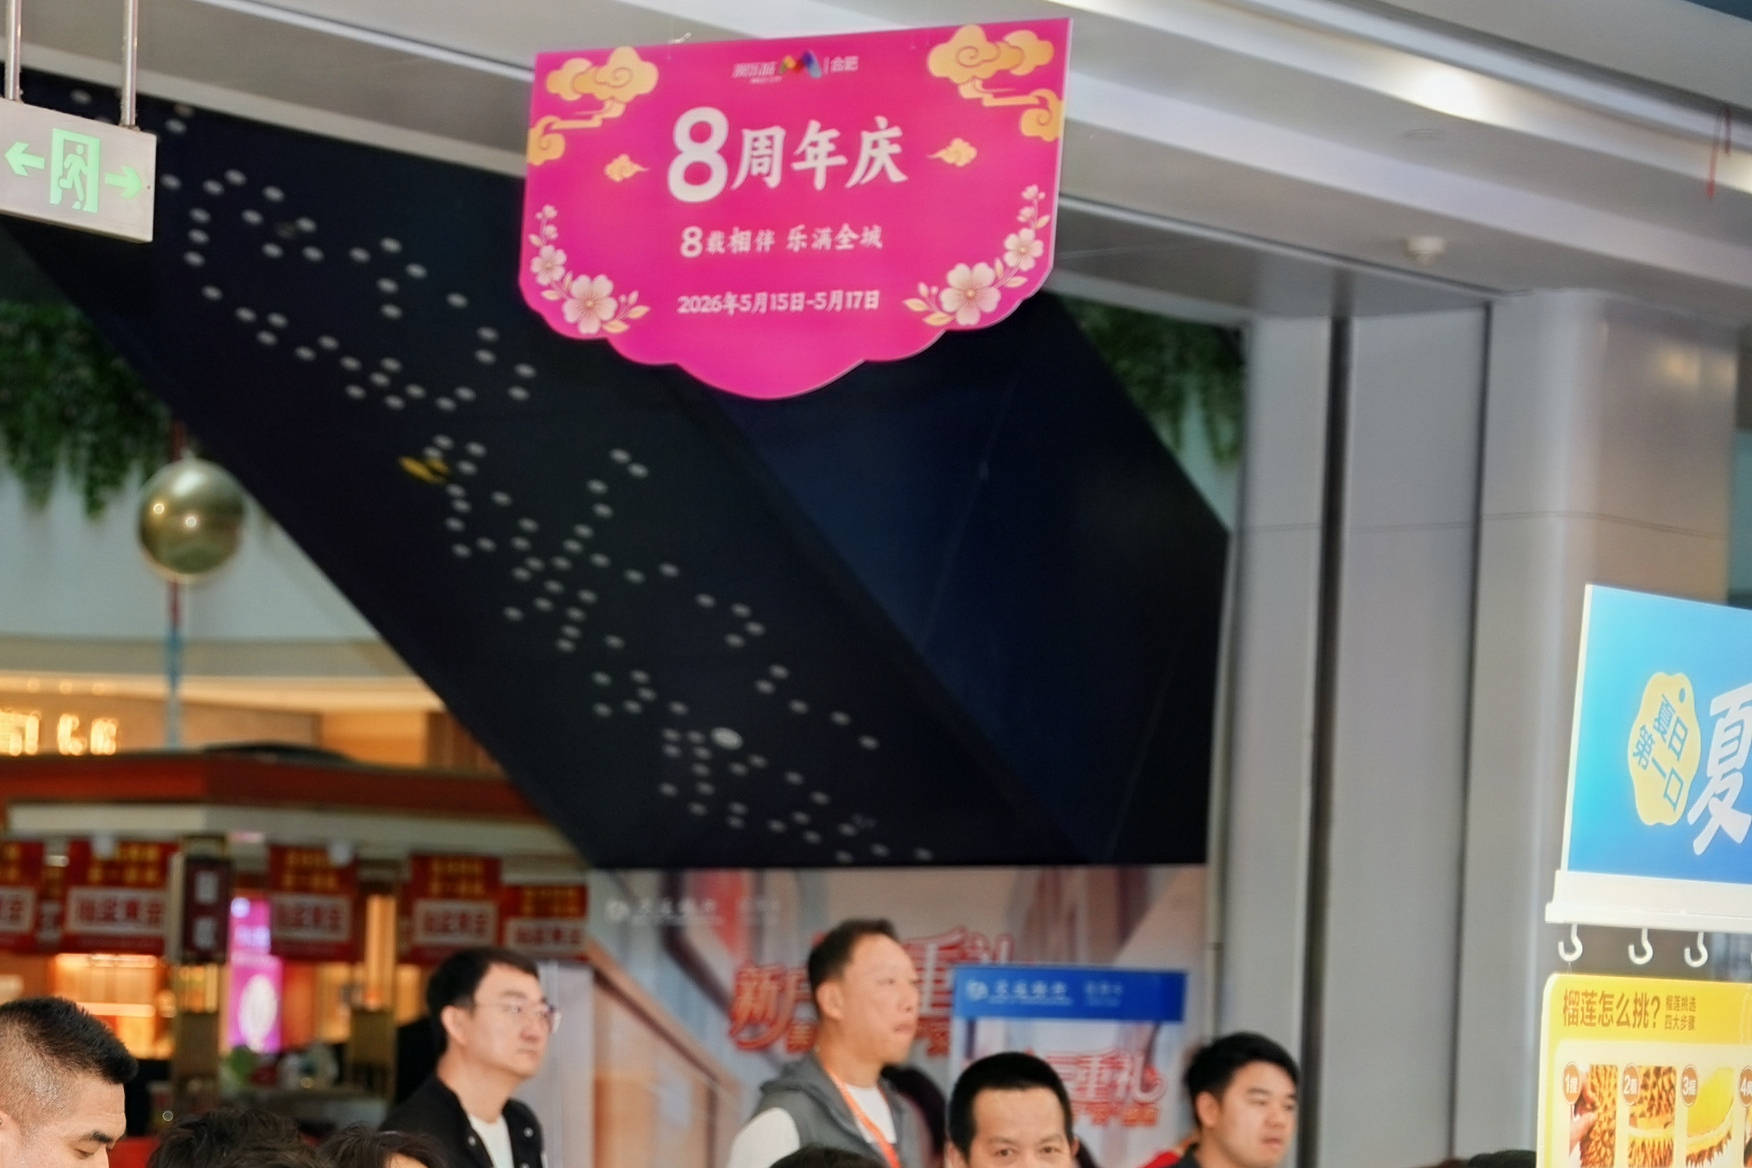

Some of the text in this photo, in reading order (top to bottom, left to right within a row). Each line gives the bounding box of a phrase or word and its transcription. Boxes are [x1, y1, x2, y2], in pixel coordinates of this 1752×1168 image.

[667, 106, 909, 203] 8周年庆
[680, 223, 884, 258] 8载相伴 乐满全城
[677, 289, 880, 316] 2026年5月15日-5月17日
